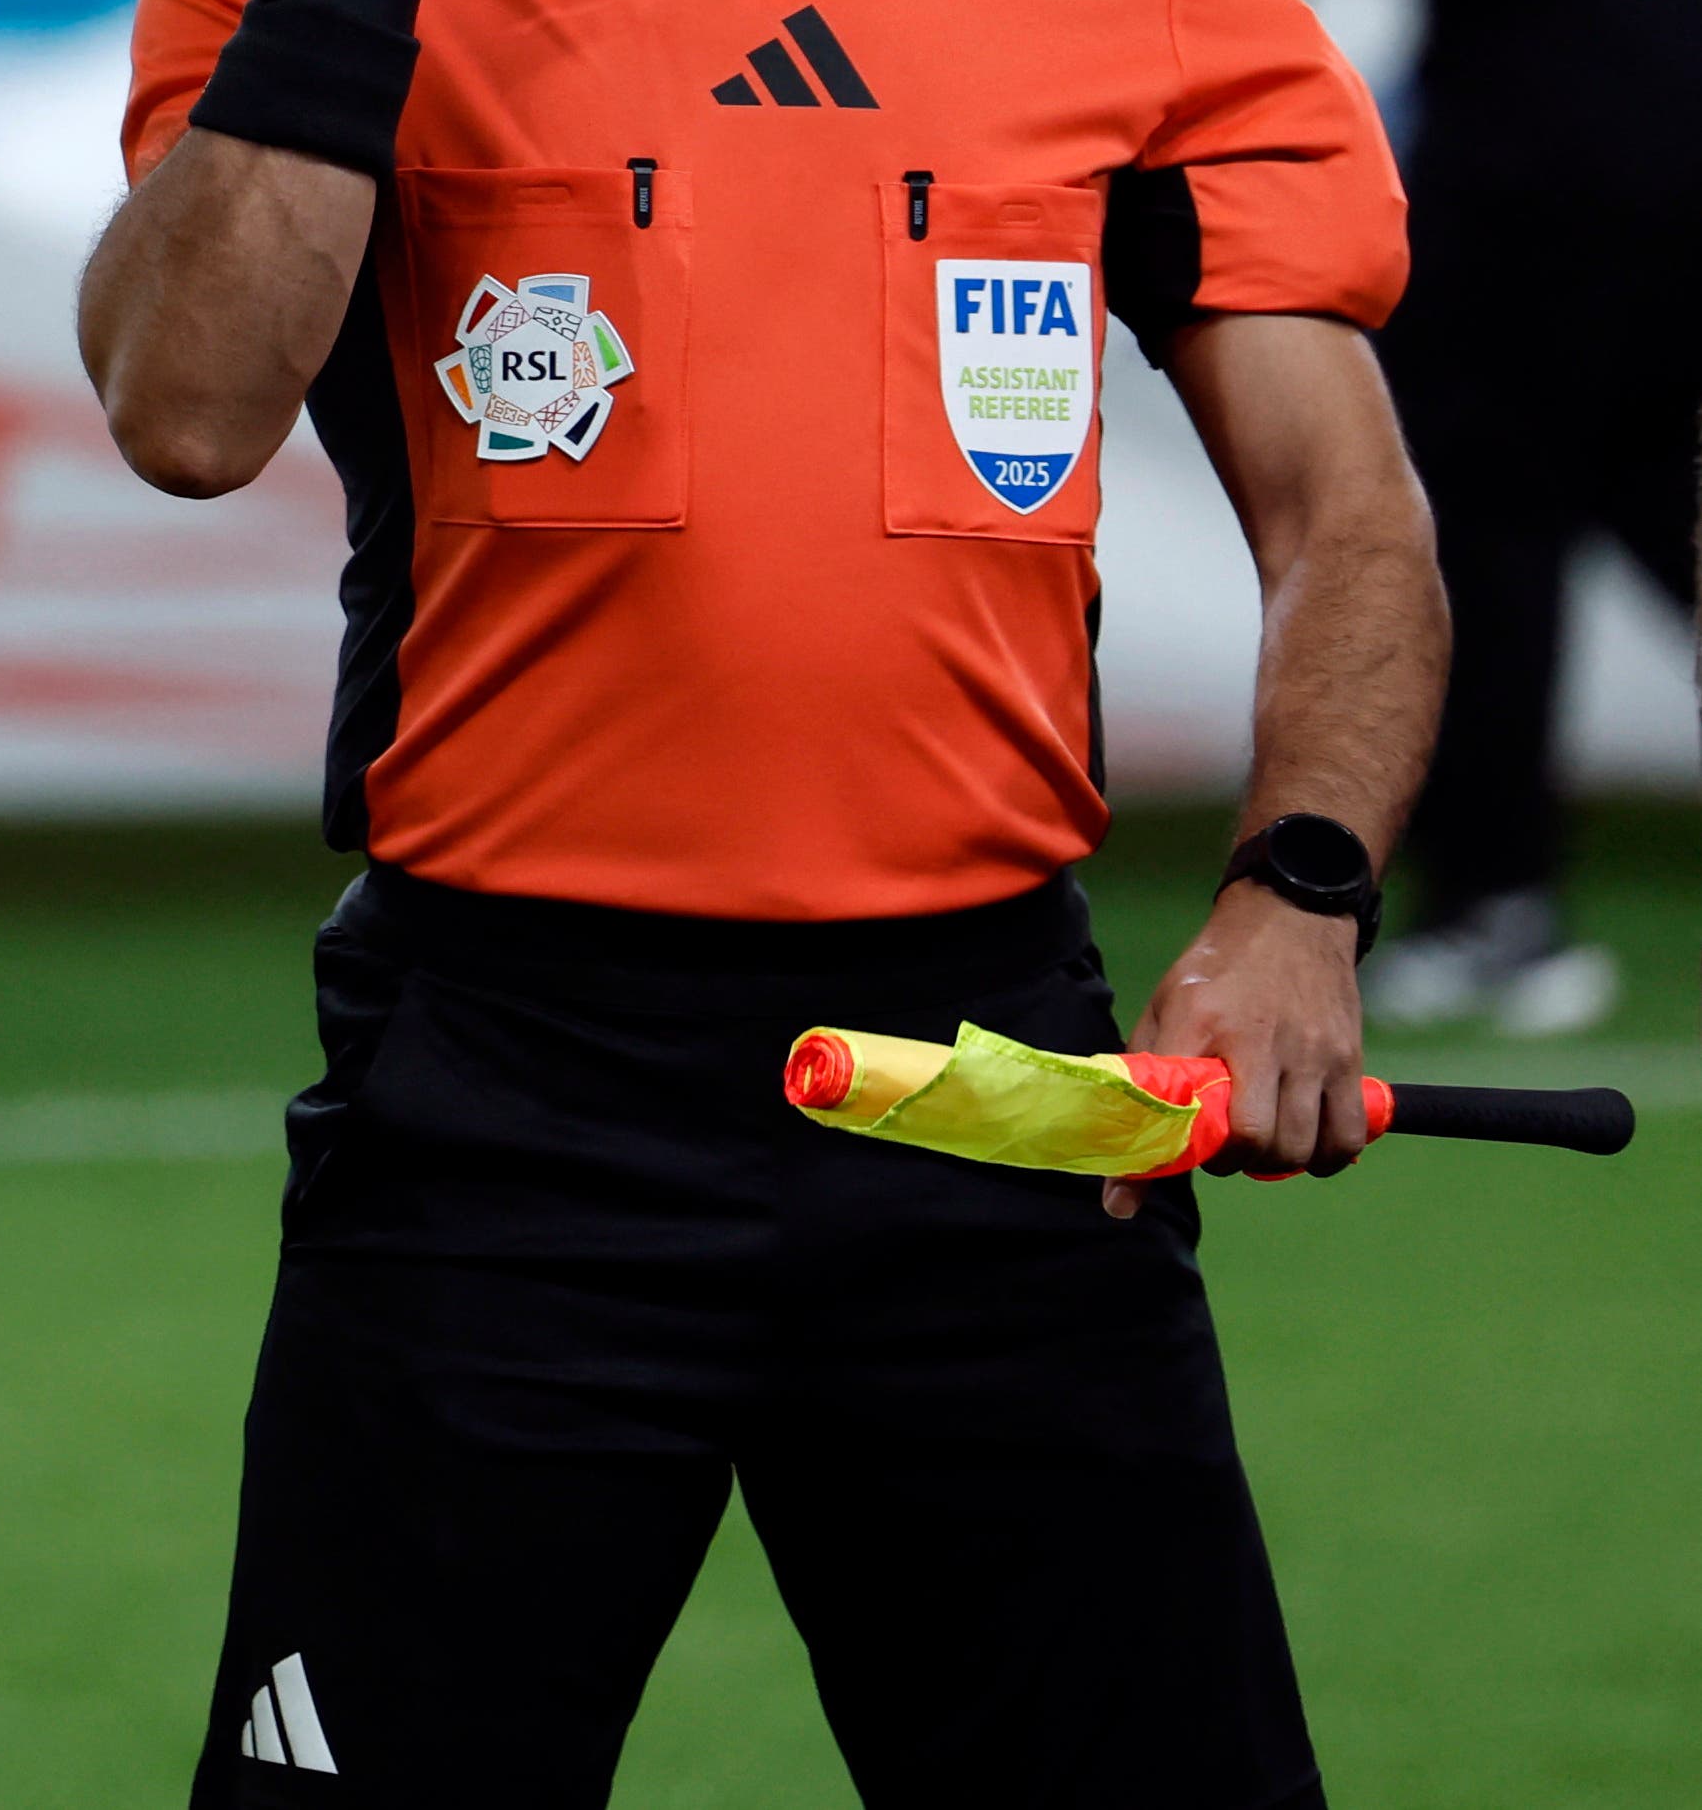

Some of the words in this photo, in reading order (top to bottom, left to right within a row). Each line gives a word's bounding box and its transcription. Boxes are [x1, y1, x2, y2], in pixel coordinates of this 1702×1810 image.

[954, 277, 1079, 337] FIFA
[501, 350, 568, 382] RSL
[957, 365, 1080, 391] ASSISTANT
[968, 394, 1071, 422] REFEREE
[994, 459, 1051, 488] 2025
